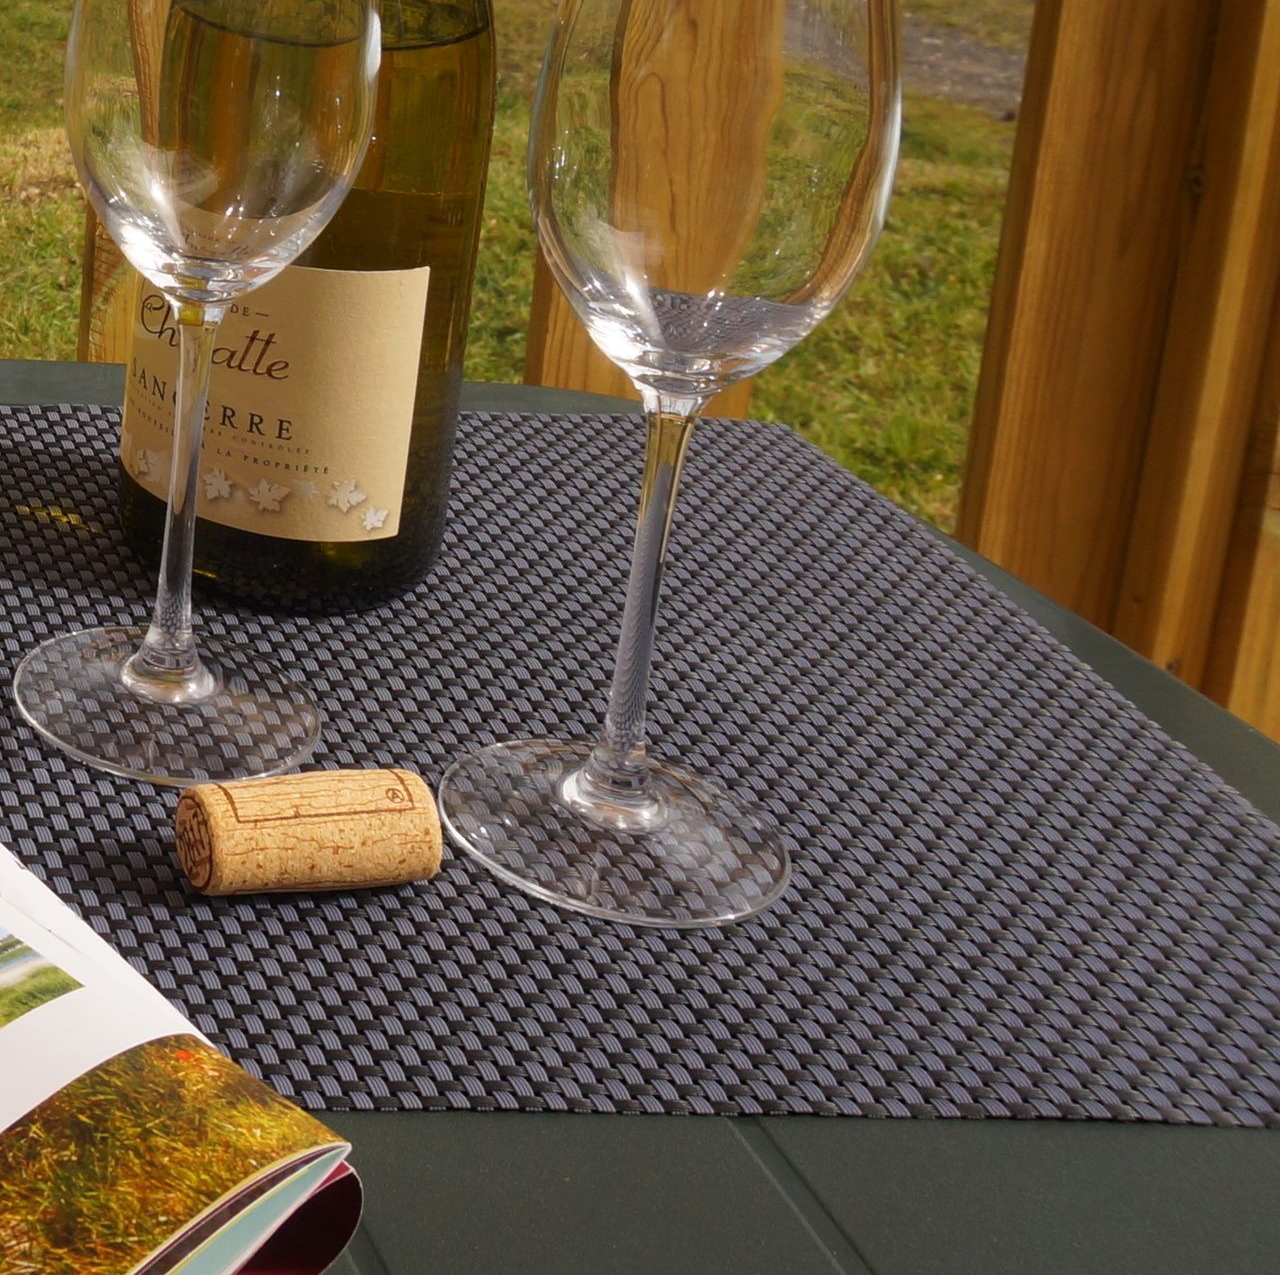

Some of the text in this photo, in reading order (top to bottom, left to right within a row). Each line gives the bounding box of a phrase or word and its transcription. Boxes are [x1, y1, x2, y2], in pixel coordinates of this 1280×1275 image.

[140, 294, 290, 380] Chatte
[230, 304, 250, 317] DE
[131, 356, 293, 440] SANRRE
